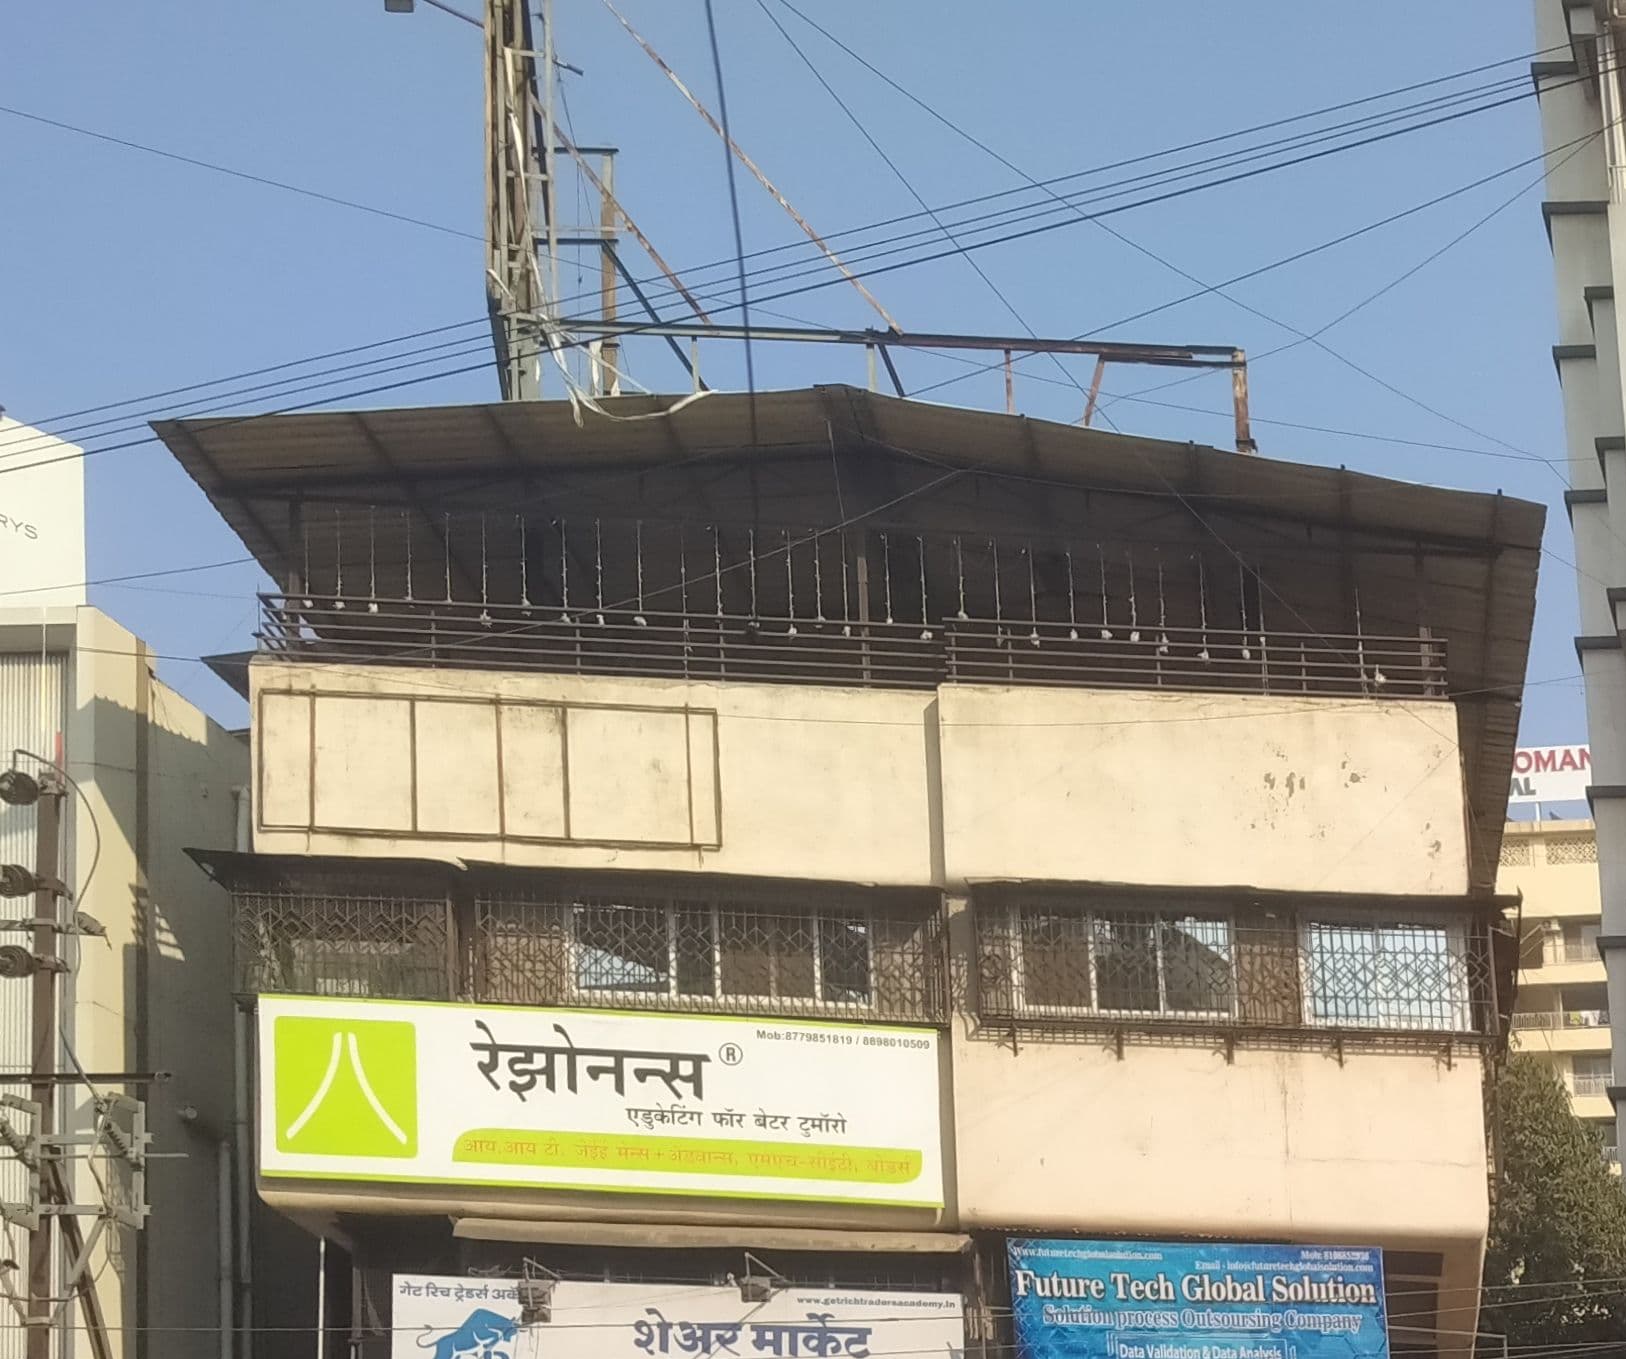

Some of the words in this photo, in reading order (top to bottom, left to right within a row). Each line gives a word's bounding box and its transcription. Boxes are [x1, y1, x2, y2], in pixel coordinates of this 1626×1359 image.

[471, 1019, 711, 1101] रेझोनन्स
[712, 1107, 747, 1129] फॉर
[753, 1108, 791, 1131] बेटर
[797, 1112, 848, 1138] टुमॉरो
[399, 1281, 421, 1297] गेट
[1015, 1270, 1105, 1299] Future
[1110, 1272, 1176, 1301] Tech
[1181, 1274, 1266, 1302] Global
[1272, 1276, 1377, 1304] Solution
[634, 1307, 743, 1357] शेअर
[750, 1312, 873, 1359] मार्केट
[1043, 1304, 1113, 1326] Solution
[1115, 1309, 1179, 1330] process
[1283, 1309, 1363, 1335] Company
[1119, 1343, 1145, 1359] Data
[1146, 1344, 1200, 1359] Validation
[1202, 1346, 1212, 1359] &
[1213, 1346, 1238, 1359] Data
